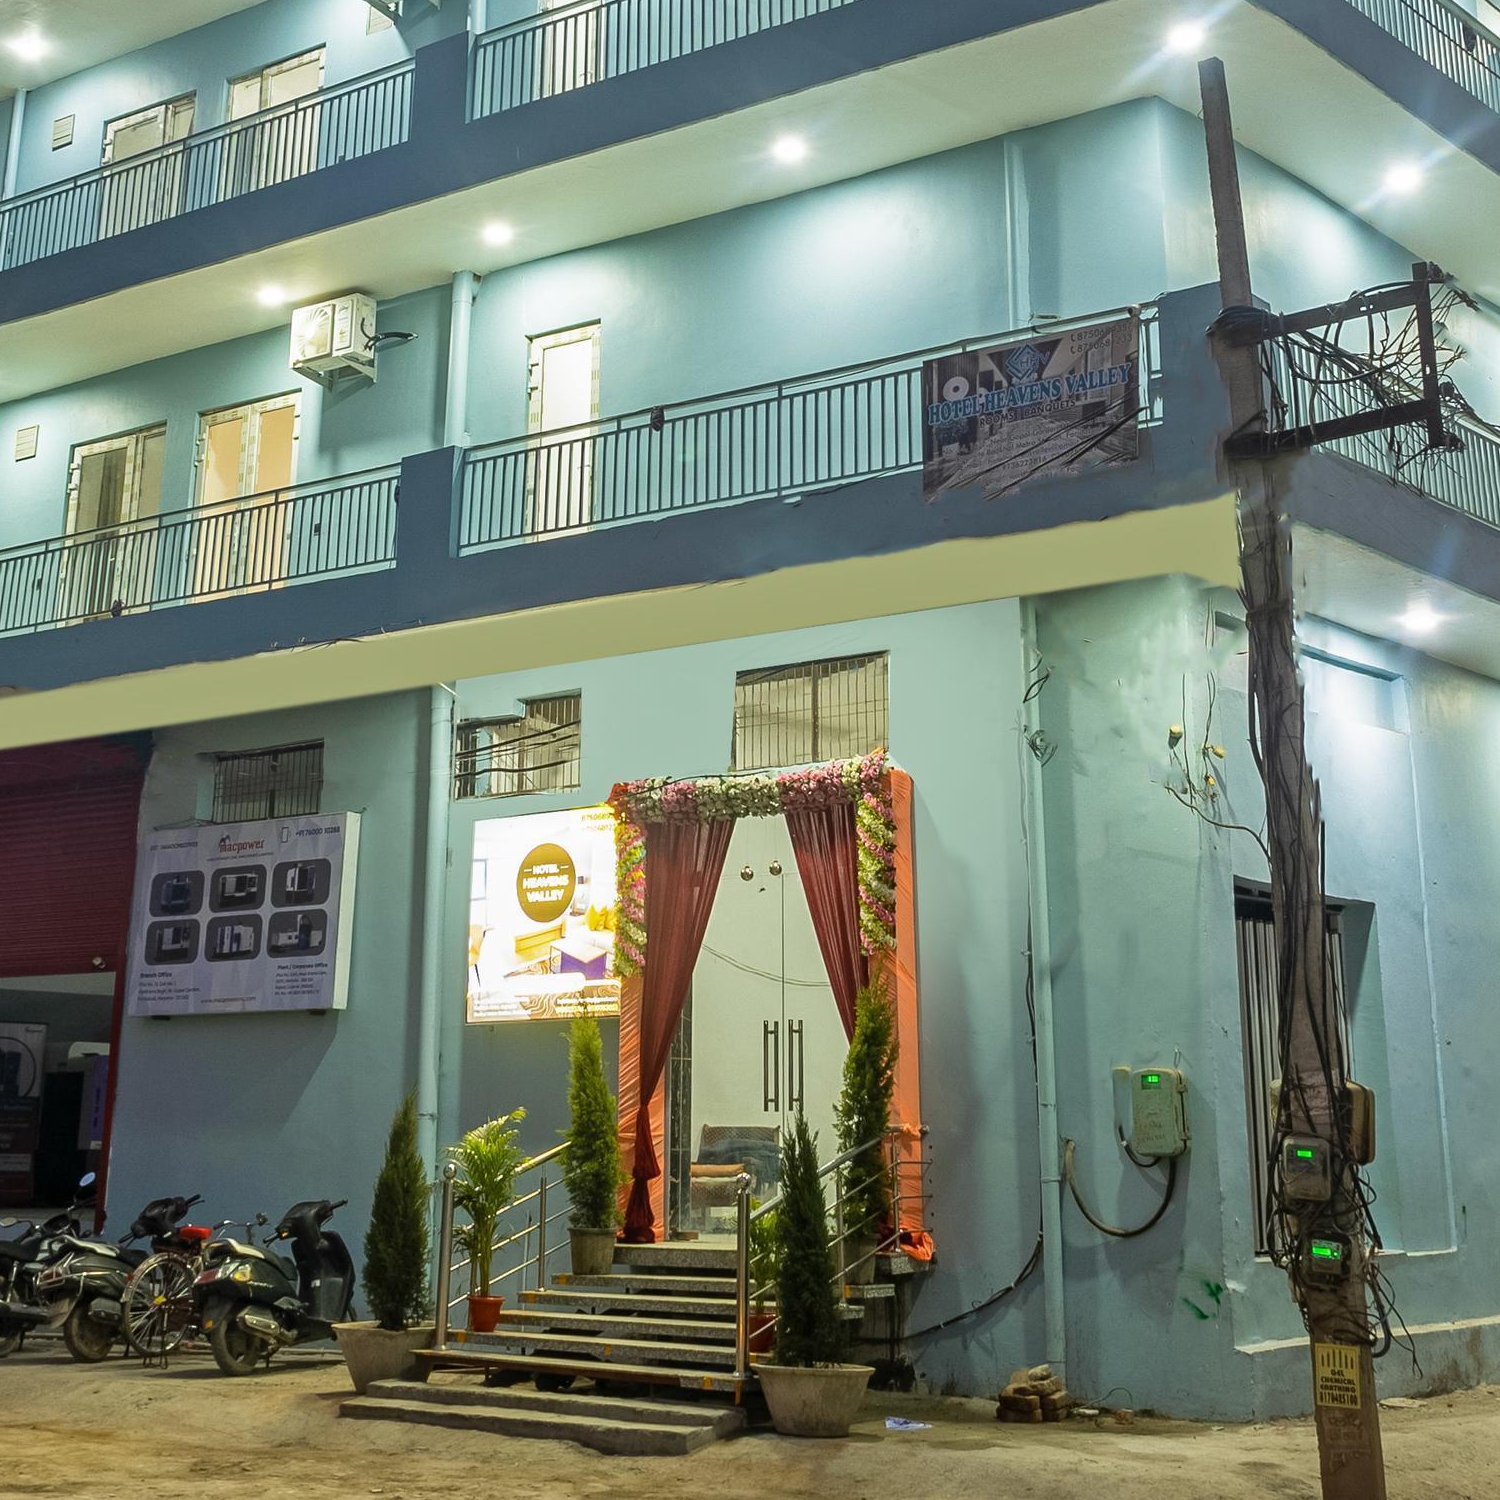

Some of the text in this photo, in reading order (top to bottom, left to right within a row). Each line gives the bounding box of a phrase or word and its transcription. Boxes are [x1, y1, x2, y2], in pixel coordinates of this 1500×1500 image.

[928, 363, 1132, 425] HOTEL HEAVENS VALLEY
[979, 400, 1076, 428] ROOMS BANQUETS
[532, 864, 560, 875] HOTEL
[522, 874, 569, 889] HEAVENS
[526, 889, 564, 902] VALLEY
[1320, 1375, 1356, 1386] CHEMICAL
